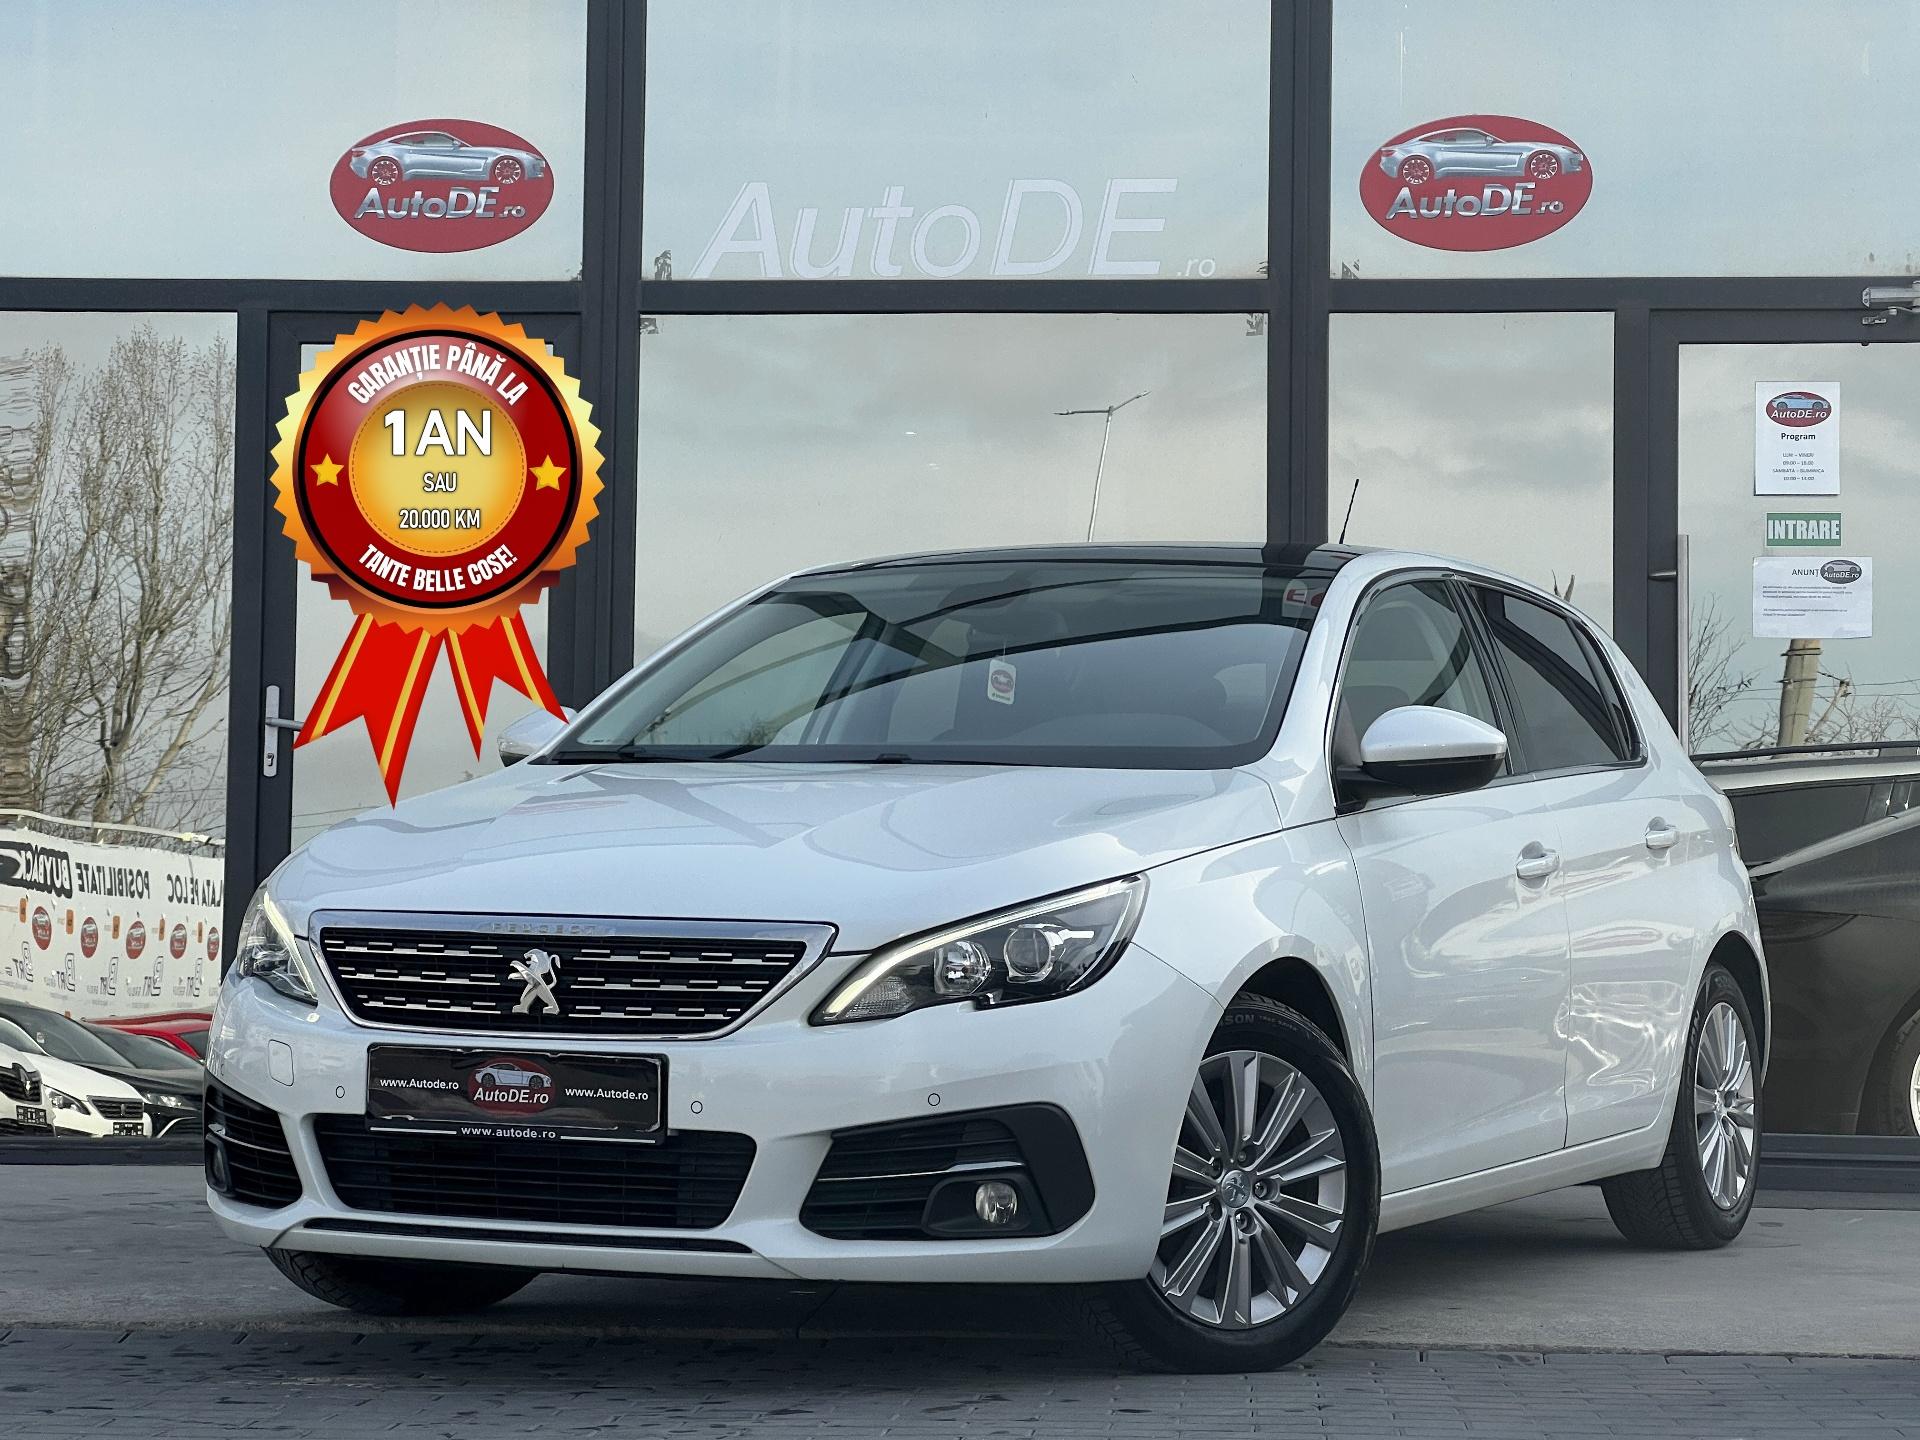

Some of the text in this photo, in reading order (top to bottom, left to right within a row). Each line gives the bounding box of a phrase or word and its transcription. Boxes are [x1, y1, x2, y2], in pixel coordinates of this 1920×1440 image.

[1781, 432, 1816, 441] Program
[1767, 519, 1840, 540] INTRARE
[380, 1077, 649, 1105] www.Autode.ro AutoDE.ro www.Autode.ro
[461, 1124, 556, 1139] www.autode.ro
